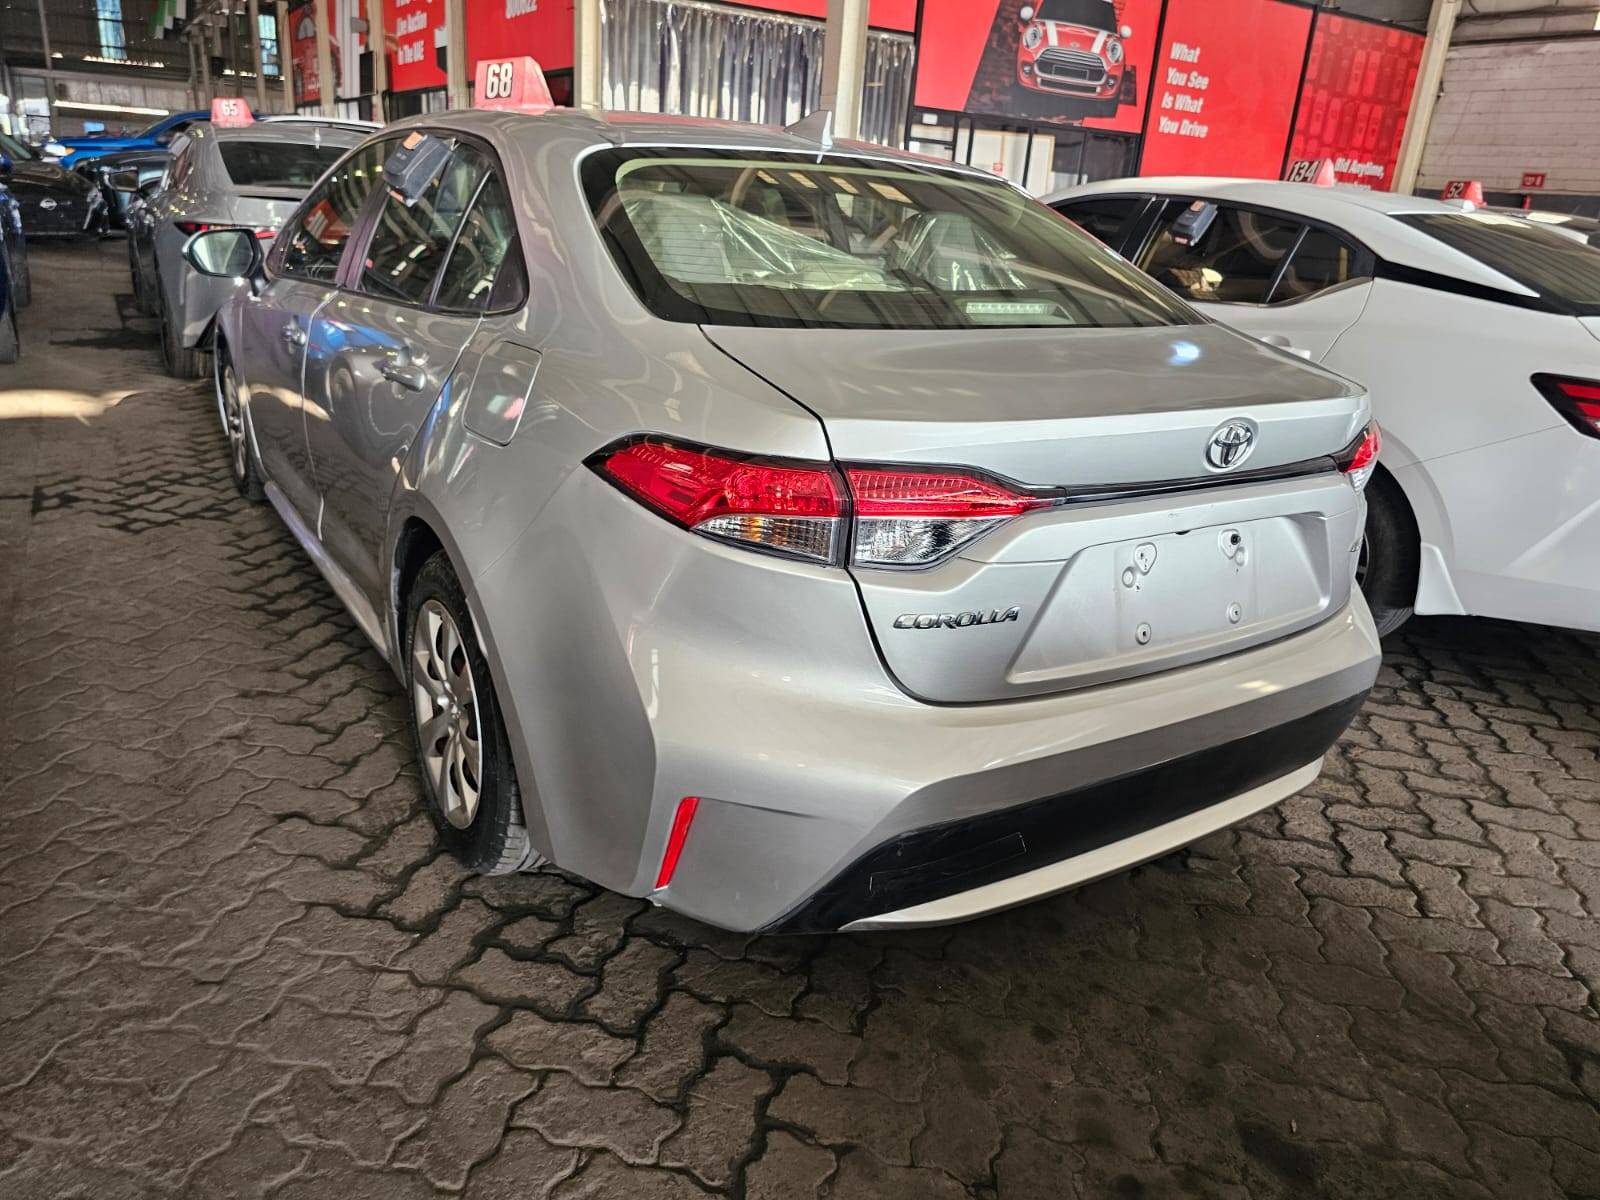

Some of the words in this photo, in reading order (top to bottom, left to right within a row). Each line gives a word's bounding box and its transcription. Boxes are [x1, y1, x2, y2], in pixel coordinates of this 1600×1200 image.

[1170, 42, 1200, 63] What
[486, 62, 513, 99] 68
[1166, 67, 1187, 86] You
[1187, 71, 1209, 90] See
[222, 98, 239, 116] 65
[1161, 91, 1174, 109] Is
[1174, 93, 1203, 113] What
[1158, 116, 1179, 134] You
[1179, 118, 1209, 138] Drive
[1289, 161, 1320, 182] 134
[1446, 182, 1465, 199] 52
[892, 605, 1021, 629] COROLLA
